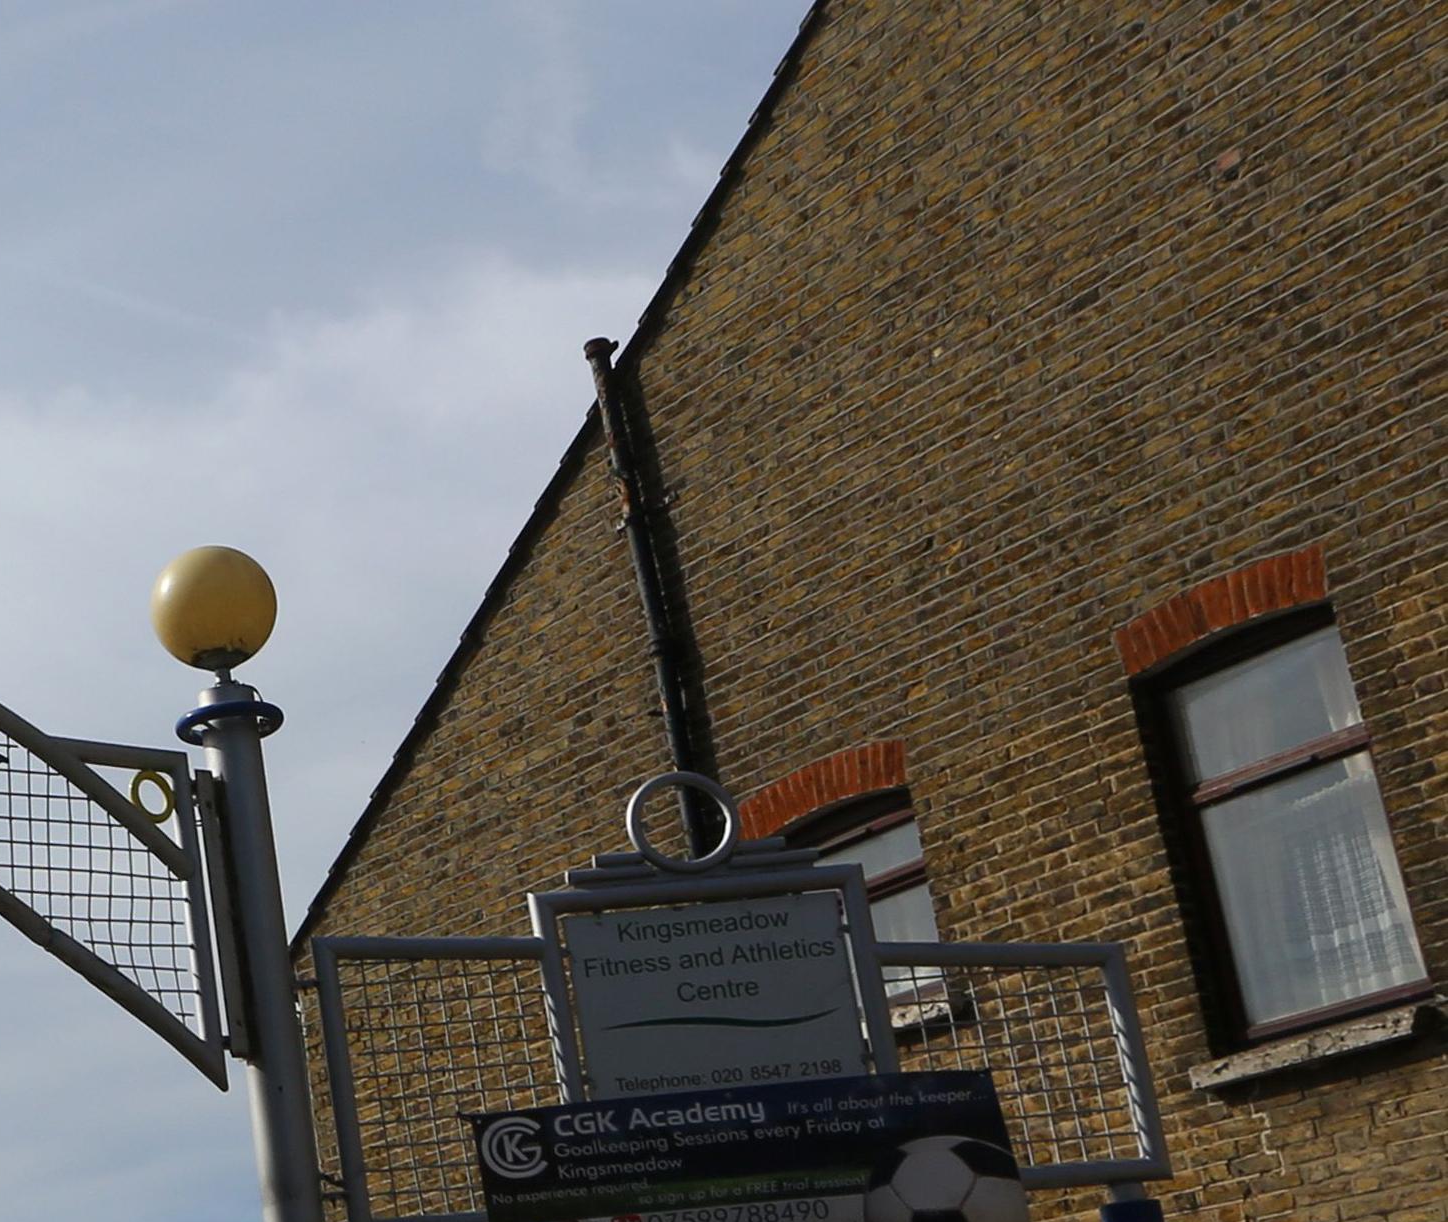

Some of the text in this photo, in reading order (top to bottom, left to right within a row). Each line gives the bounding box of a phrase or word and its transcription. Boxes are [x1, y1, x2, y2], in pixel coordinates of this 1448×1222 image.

[617, 910, 789, 944] Kingsmeadow
[583, 938, 836, 978] Fitness and Athletics
[677, 980, 760, 1003] Centre
[615, 1059, 843, 1092] Telephone: 020 8547 2198
[787, 1101, 809, 1115] It's
[813, 1098, 832, 1113] all
[838, 1096, 883, 1112] about
[890, 1092, 913, 1107] the
[554, 1100, 766, 1137] CGK Academy
[555, 1116, 886, 1158] Goalkeeping Sessions every Friday at
[557, 1156, 684, 1181] Kingsmeadow
[491, 1193, 513, 1205] No
[517, 1186, 588, 1202] experience
[689, 1189, 705, 1202] up
[710, 1184, 728, 1197] for
[746, 1182, 779, 1196] FREE
[783, 1178, 809, 1192] trial
